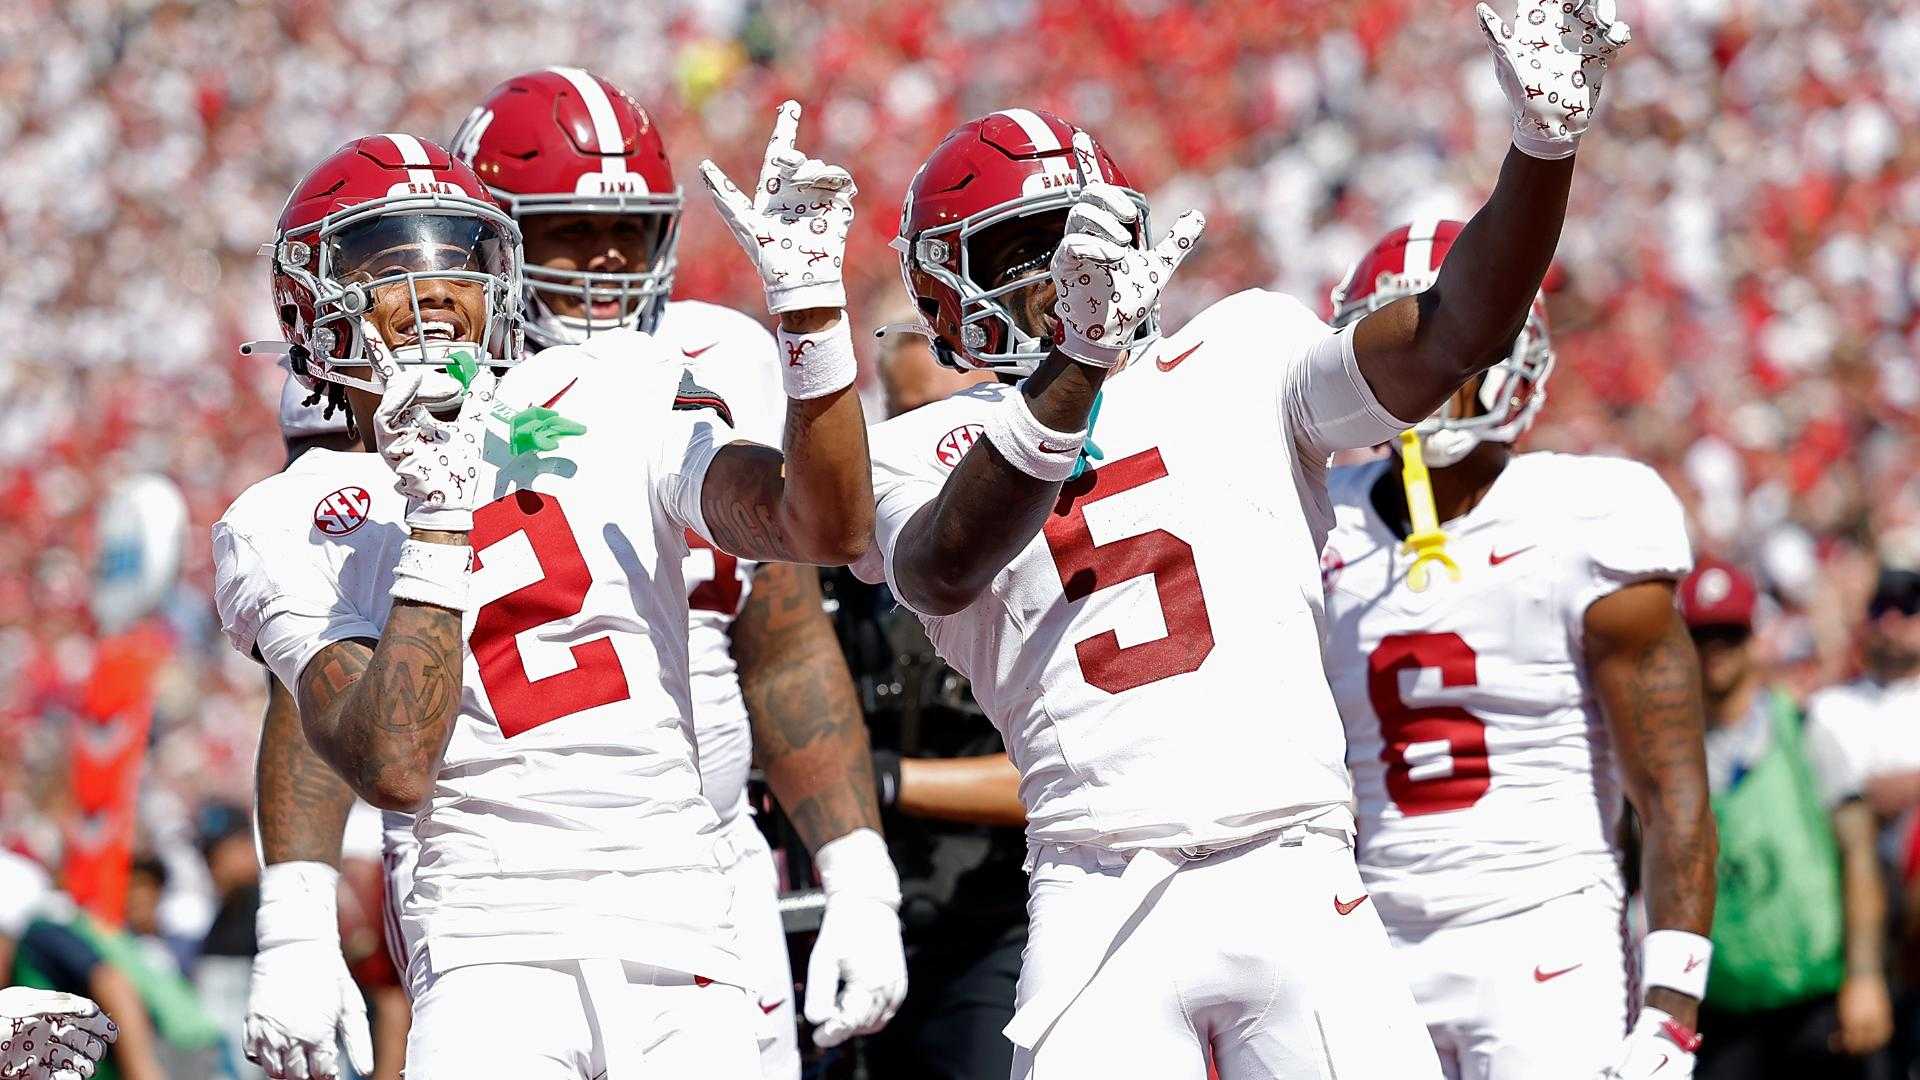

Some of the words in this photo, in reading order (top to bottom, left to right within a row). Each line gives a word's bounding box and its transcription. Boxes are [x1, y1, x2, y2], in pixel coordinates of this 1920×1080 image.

[408, 182, 453, 195] BAMA
[314, 486, 370, 535] SEC
[1043, 446, 1216, 695] 5
[469, 488, 631, 739] 2
[1366, 631, 1491, 818] 6
